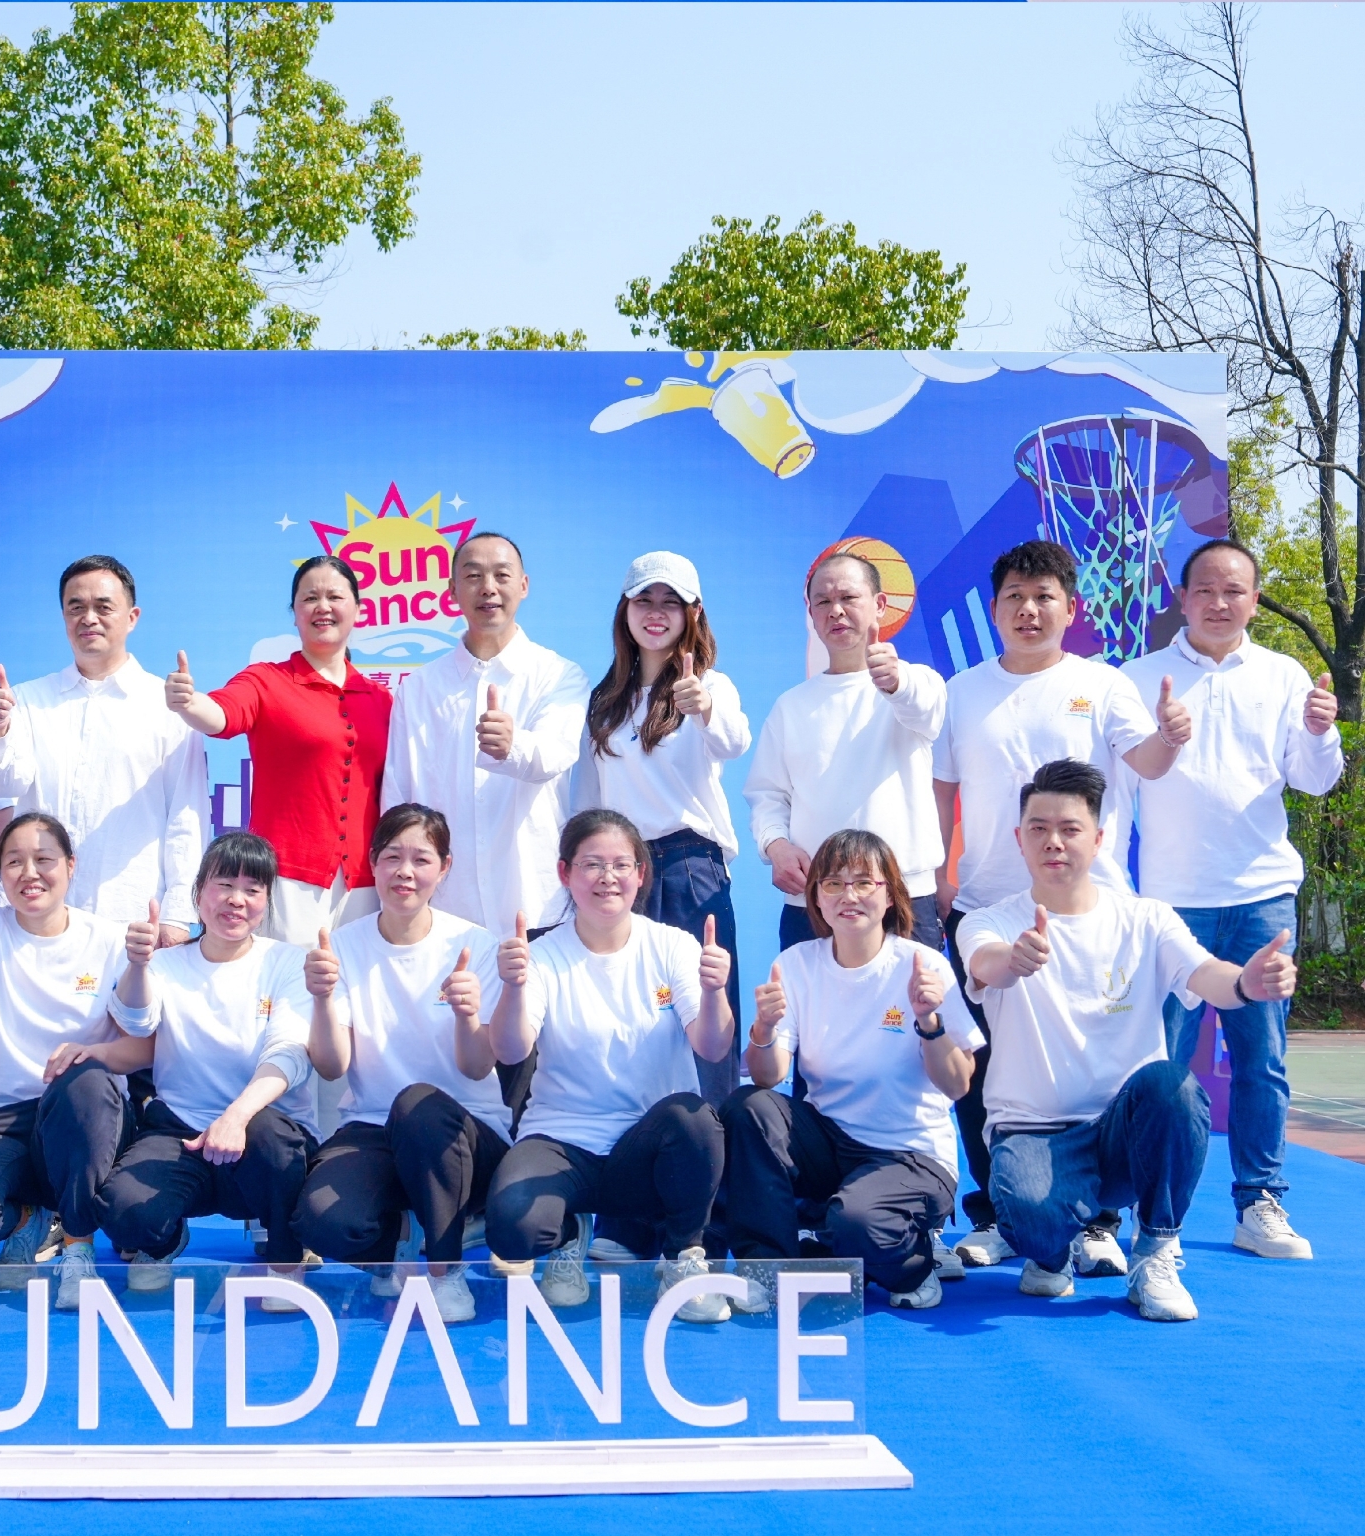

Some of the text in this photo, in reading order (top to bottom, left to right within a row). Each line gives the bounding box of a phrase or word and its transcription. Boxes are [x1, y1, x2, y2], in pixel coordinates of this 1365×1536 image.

[339, 541, 450, 590] Sun
[354, 590, 465, 628] ance
[886, 1012, 901, 1021] Sun
